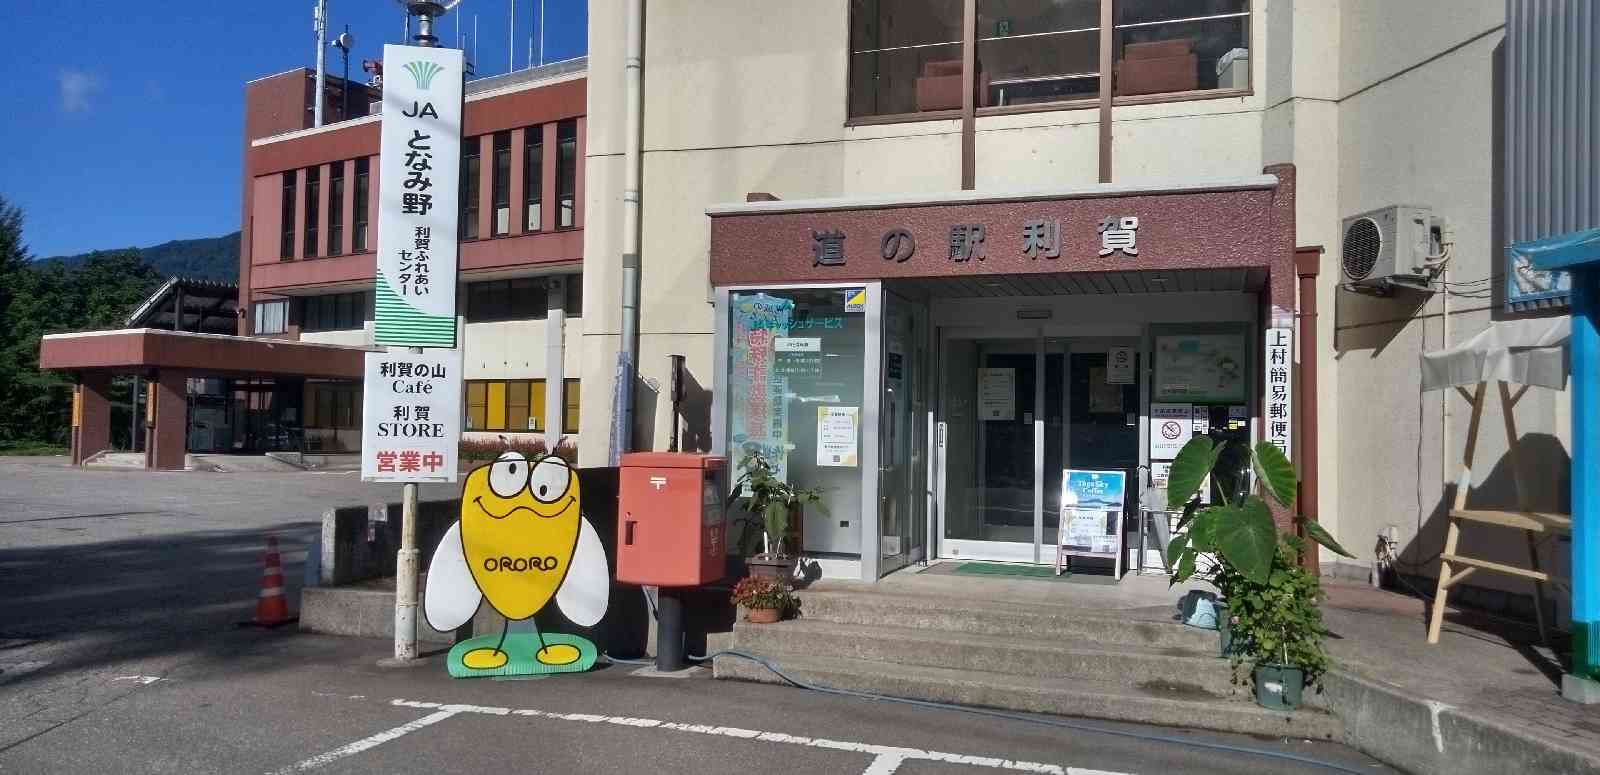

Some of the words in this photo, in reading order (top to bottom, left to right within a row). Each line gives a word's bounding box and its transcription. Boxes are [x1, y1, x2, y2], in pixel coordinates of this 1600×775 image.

[402, 102, 439, 120] JA
[402, 130, 433, 216] となみ野
[811, 215, 1140, 268] 道の駅利賀
[414, 226, 431, 296] 利賀ふれあい
[398, 250, 414, 296] センター
[380, 362, 447, 378] 利賀の山
[392, 380, 433, 394] Café
[393, 405, 431, 421] 利賀
[377, 422, 446, 438] STORE
[376, 451, 444, 473] 営業中
[484, 556, 558, 572] ORORO
